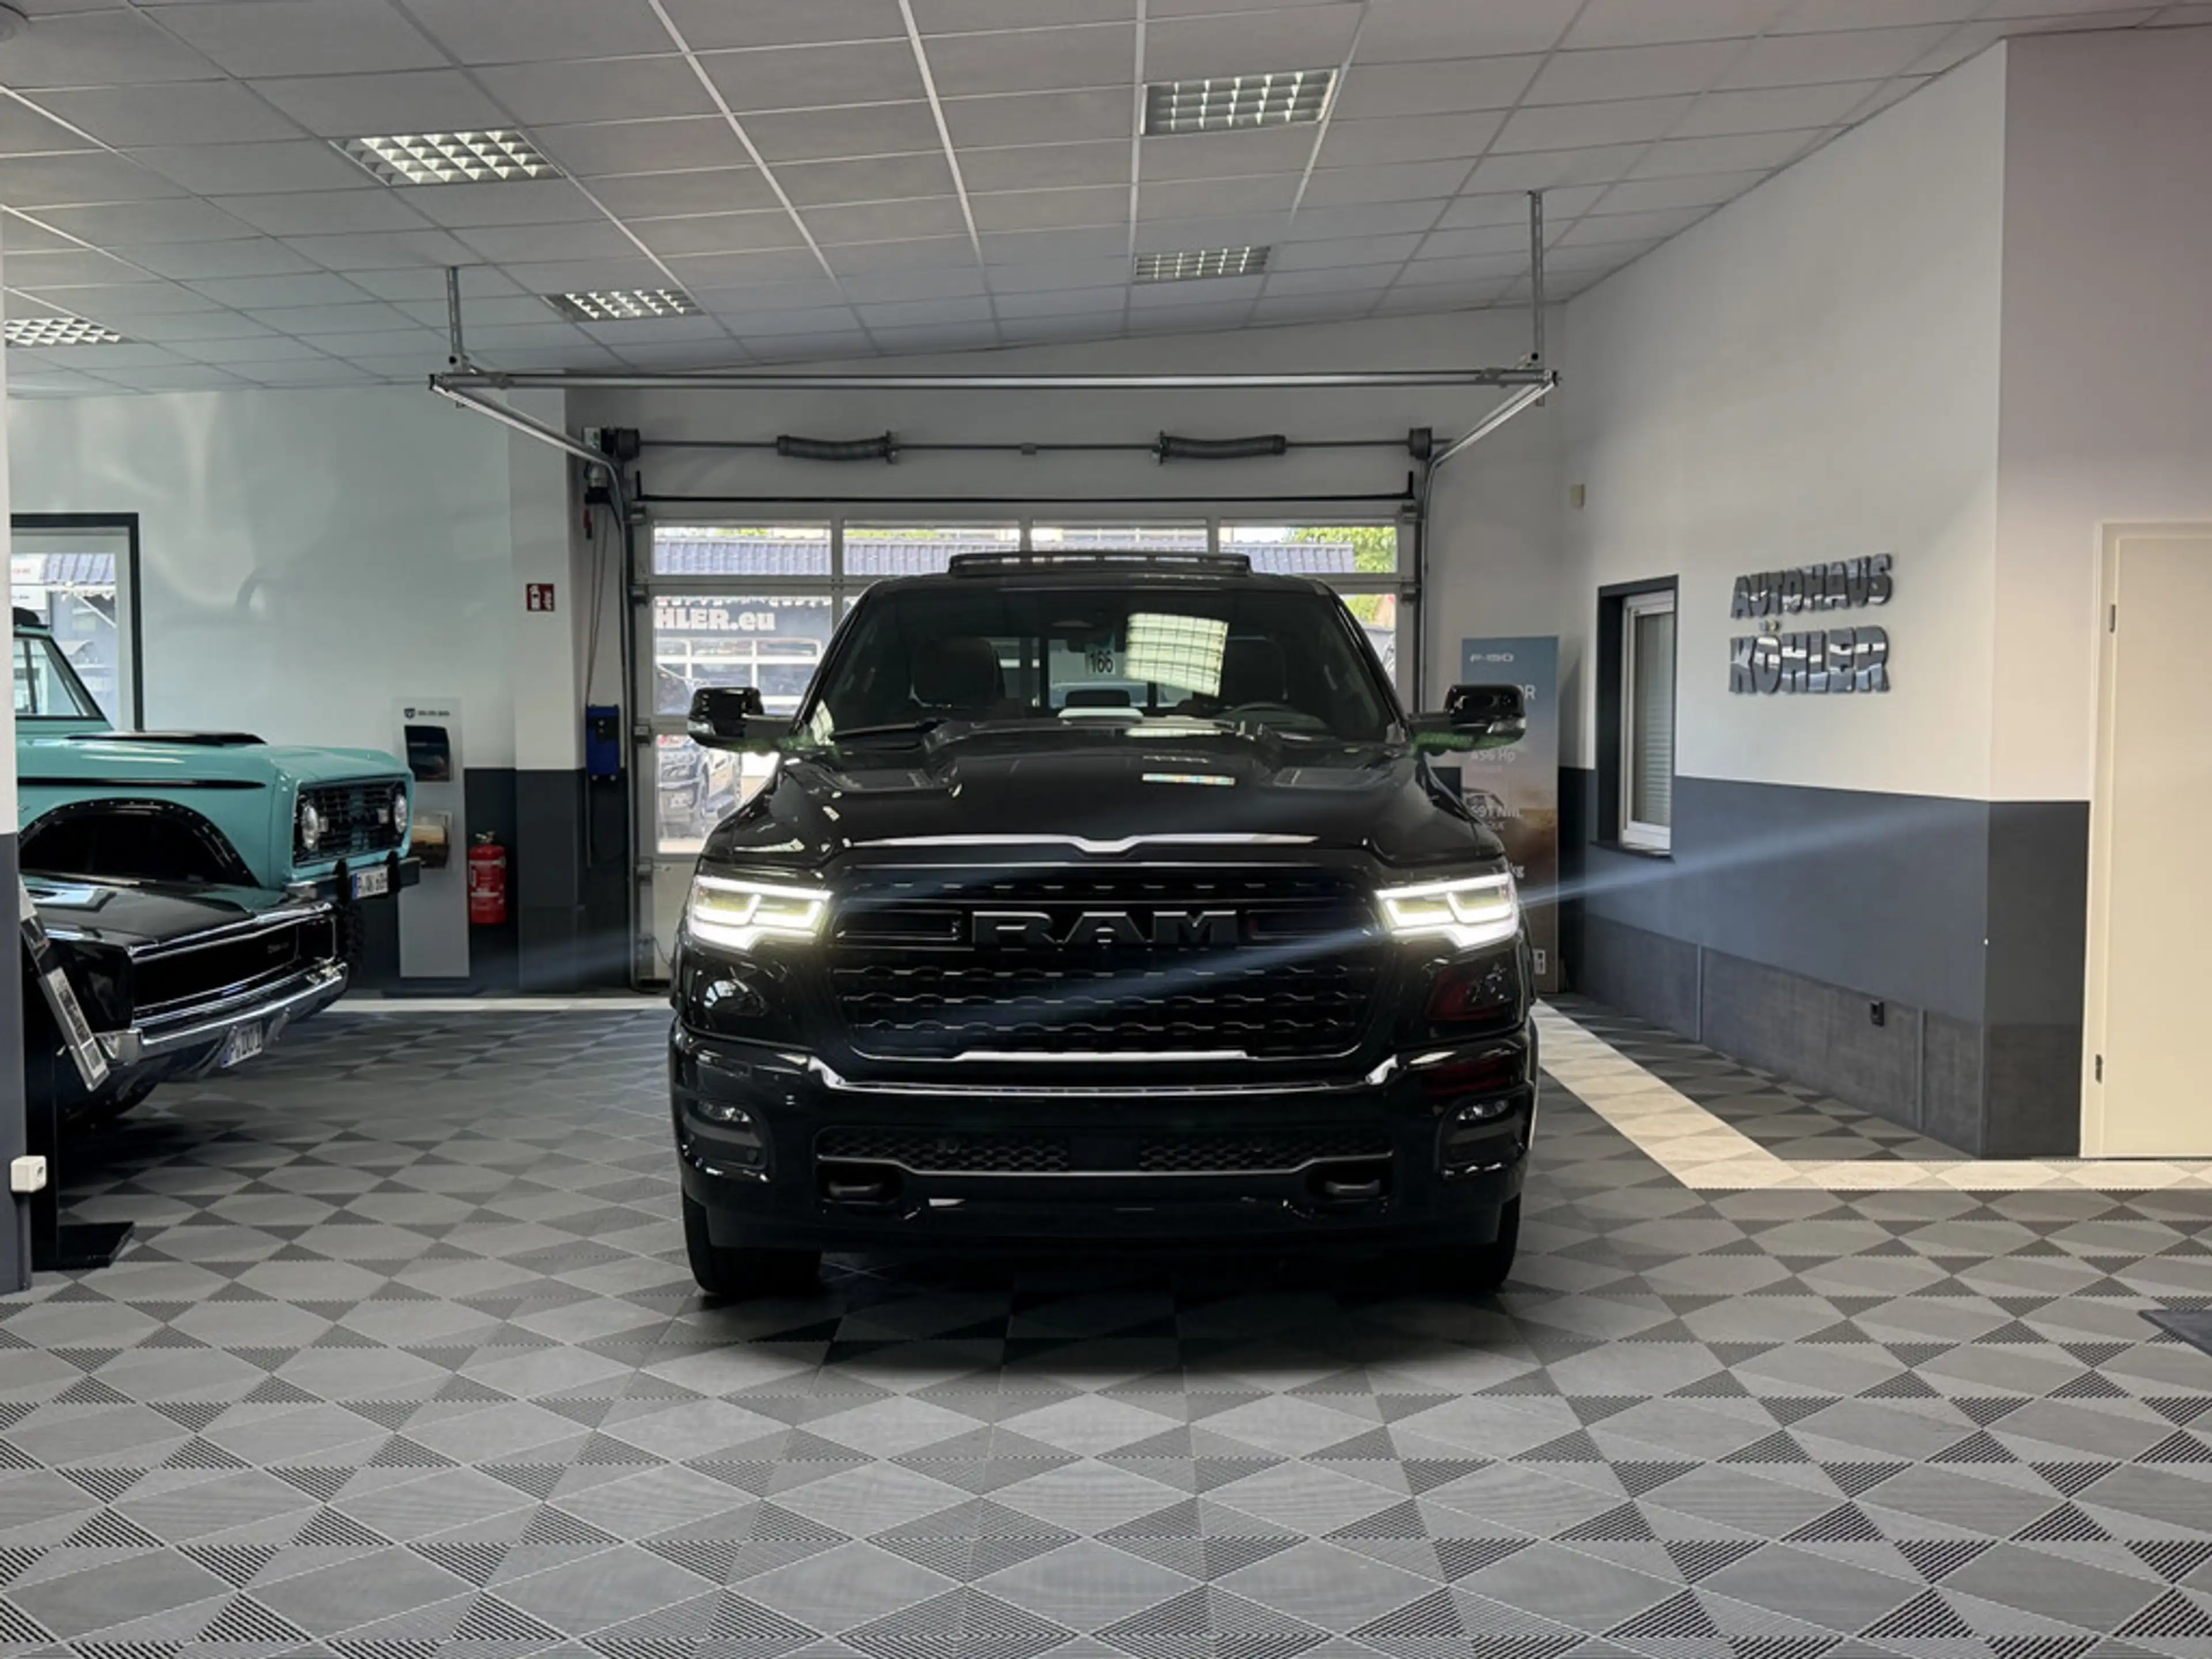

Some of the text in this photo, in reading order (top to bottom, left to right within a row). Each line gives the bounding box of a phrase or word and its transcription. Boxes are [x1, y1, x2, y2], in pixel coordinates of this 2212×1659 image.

[1730, 552, 1893, 619] AUTOHAUS
[1729, 619, 1891, 694] KÖHLER
[971, 910, 1238, 948] RAM
